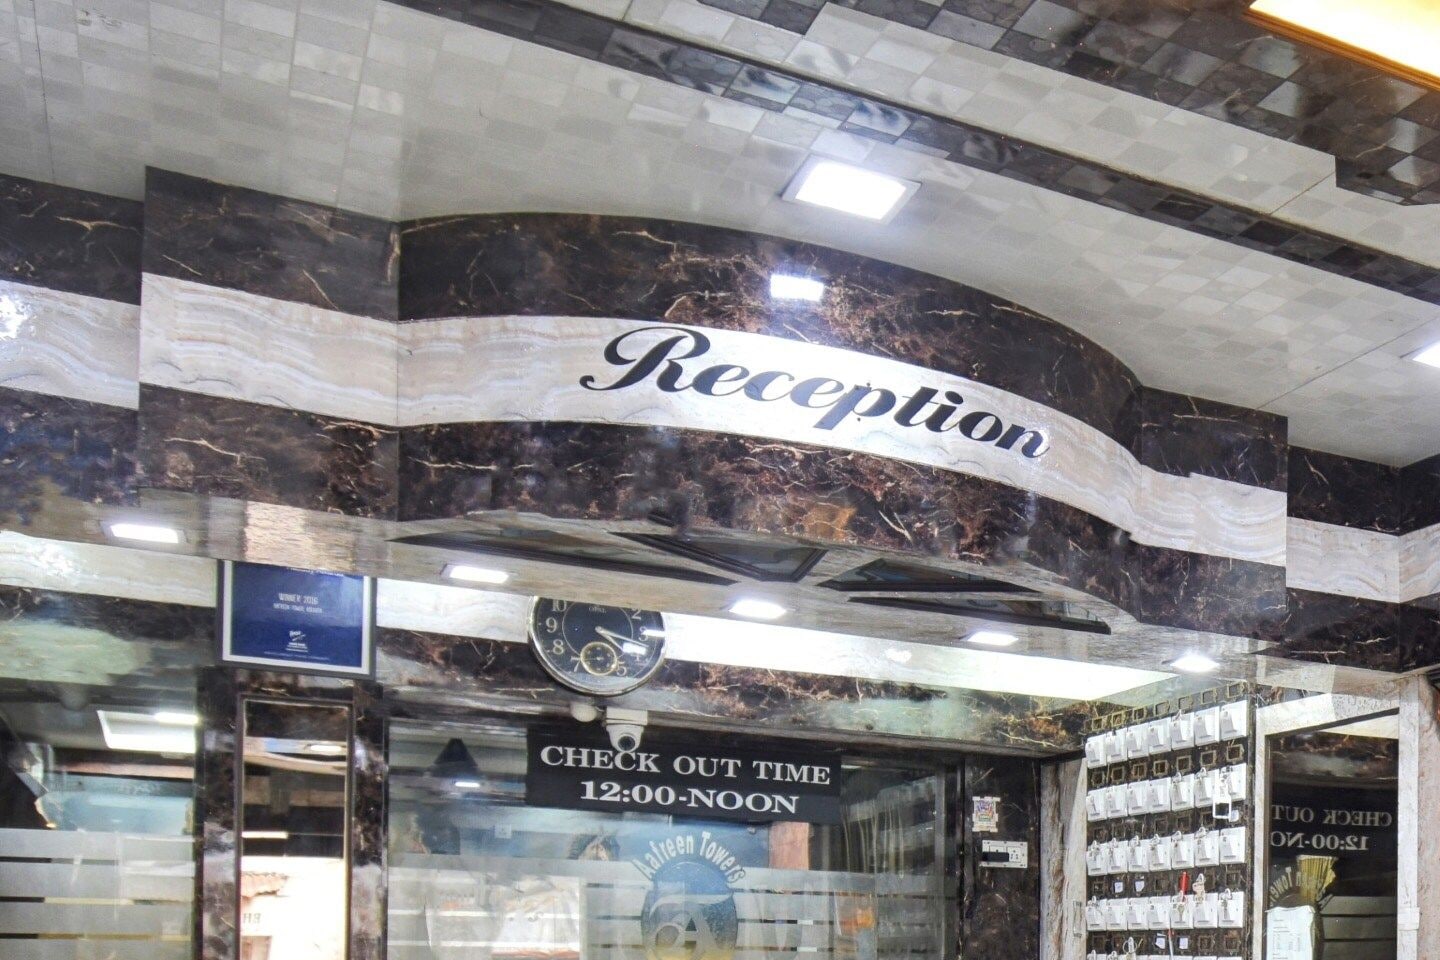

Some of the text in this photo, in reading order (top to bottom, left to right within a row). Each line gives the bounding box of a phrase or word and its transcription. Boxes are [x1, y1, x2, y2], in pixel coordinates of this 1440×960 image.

[579, 326, 1051, 458] Reception
[545, 617, 558, 634] 9
[552, 639, 565, 655] 8
[616, 661, 627, 677] 5
[540, 745, 831, 785] CHECK OUT TIME
[579, 780, 799, 814] 12:00-NOON
[632, 830, 746, 883] Aafreen Towers
